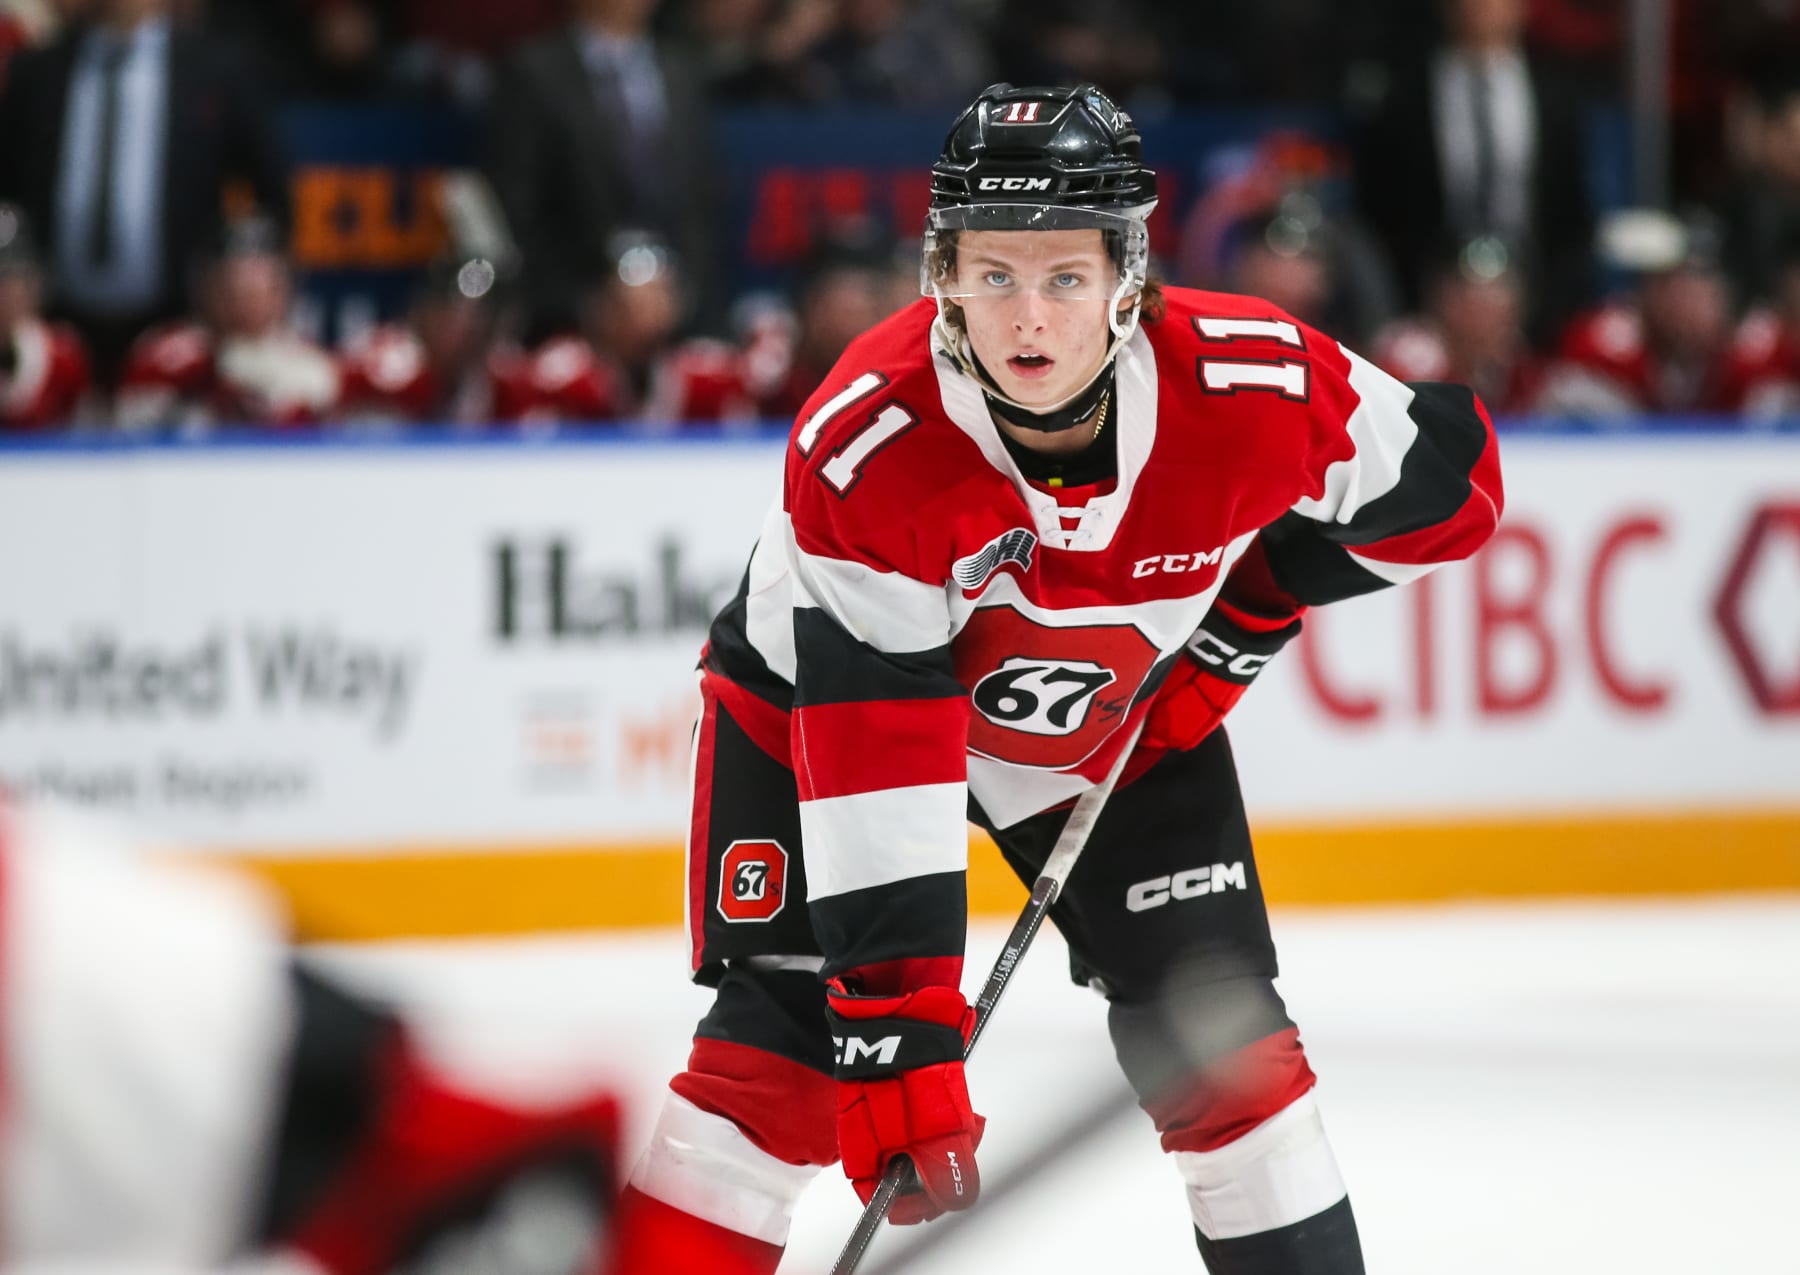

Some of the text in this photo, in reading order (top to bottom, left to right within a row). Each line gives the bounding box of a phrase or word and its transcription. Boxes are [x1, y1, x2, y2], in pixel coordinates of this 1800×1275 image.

[1004, 101, 1042, 123] 11
[978, 177, 1052, 191] CCM
[1190, 315, 1311, 404] 11
[795, 369, 922, 501] 11
[1132, 545, 1224, 579] CCM
[1126, 861, 1247, 912] CCM
[947, 1151, 964, 1196] CCM
